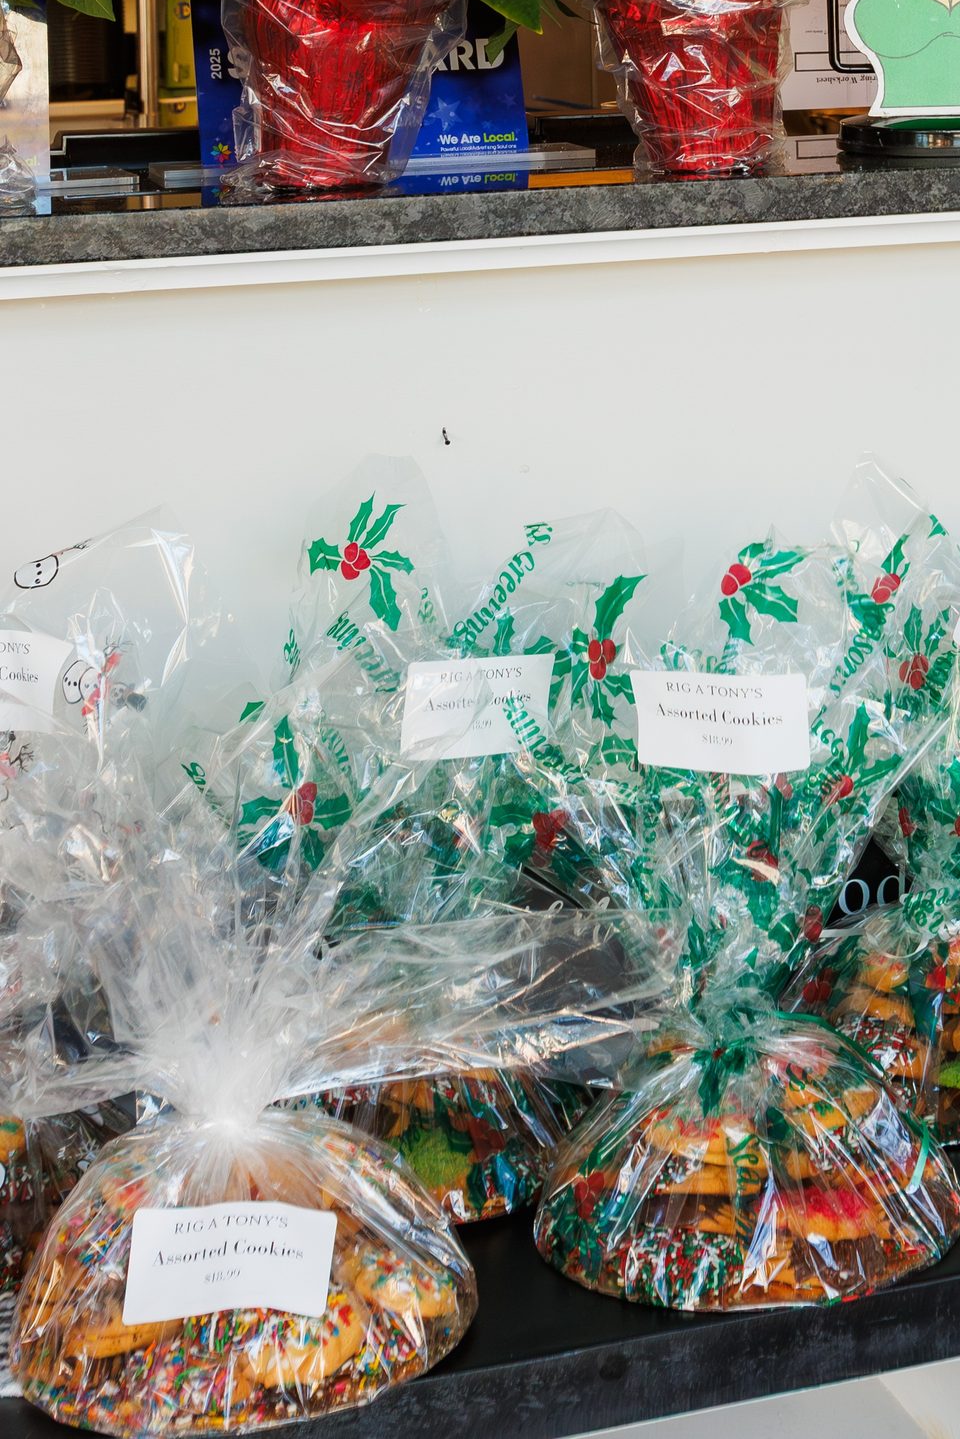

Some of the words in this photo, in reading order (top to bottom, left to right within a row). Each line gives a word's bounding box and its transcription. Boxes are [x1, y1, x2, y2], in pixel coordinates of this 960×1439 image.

[209, 48, 222, 80] 2025
[816, 75, 857, 85] Worksheet
[439, 134, 459, 145] We
[461, 133, 481, 144] Are
[666, 681, 691, 693] RIG
[695, 683, 705, 695] A
[707, 684, 764, 700] TONY'S
[657, 702, 717, 722] Assorted
[721, 709, 783, 727] Cookies
[702, 733, 733, 746] $18.99
[174, 1221, 203, 1235] RIG
[208, 1217, 218, 1230] A
[222, 1213, 289, 1230] TONY'S
[152, 1240, 227, 1266] Assorted
[233, 1238, 304, 1259] Cookies
[204, 1268, 242, 1283] $18.99
